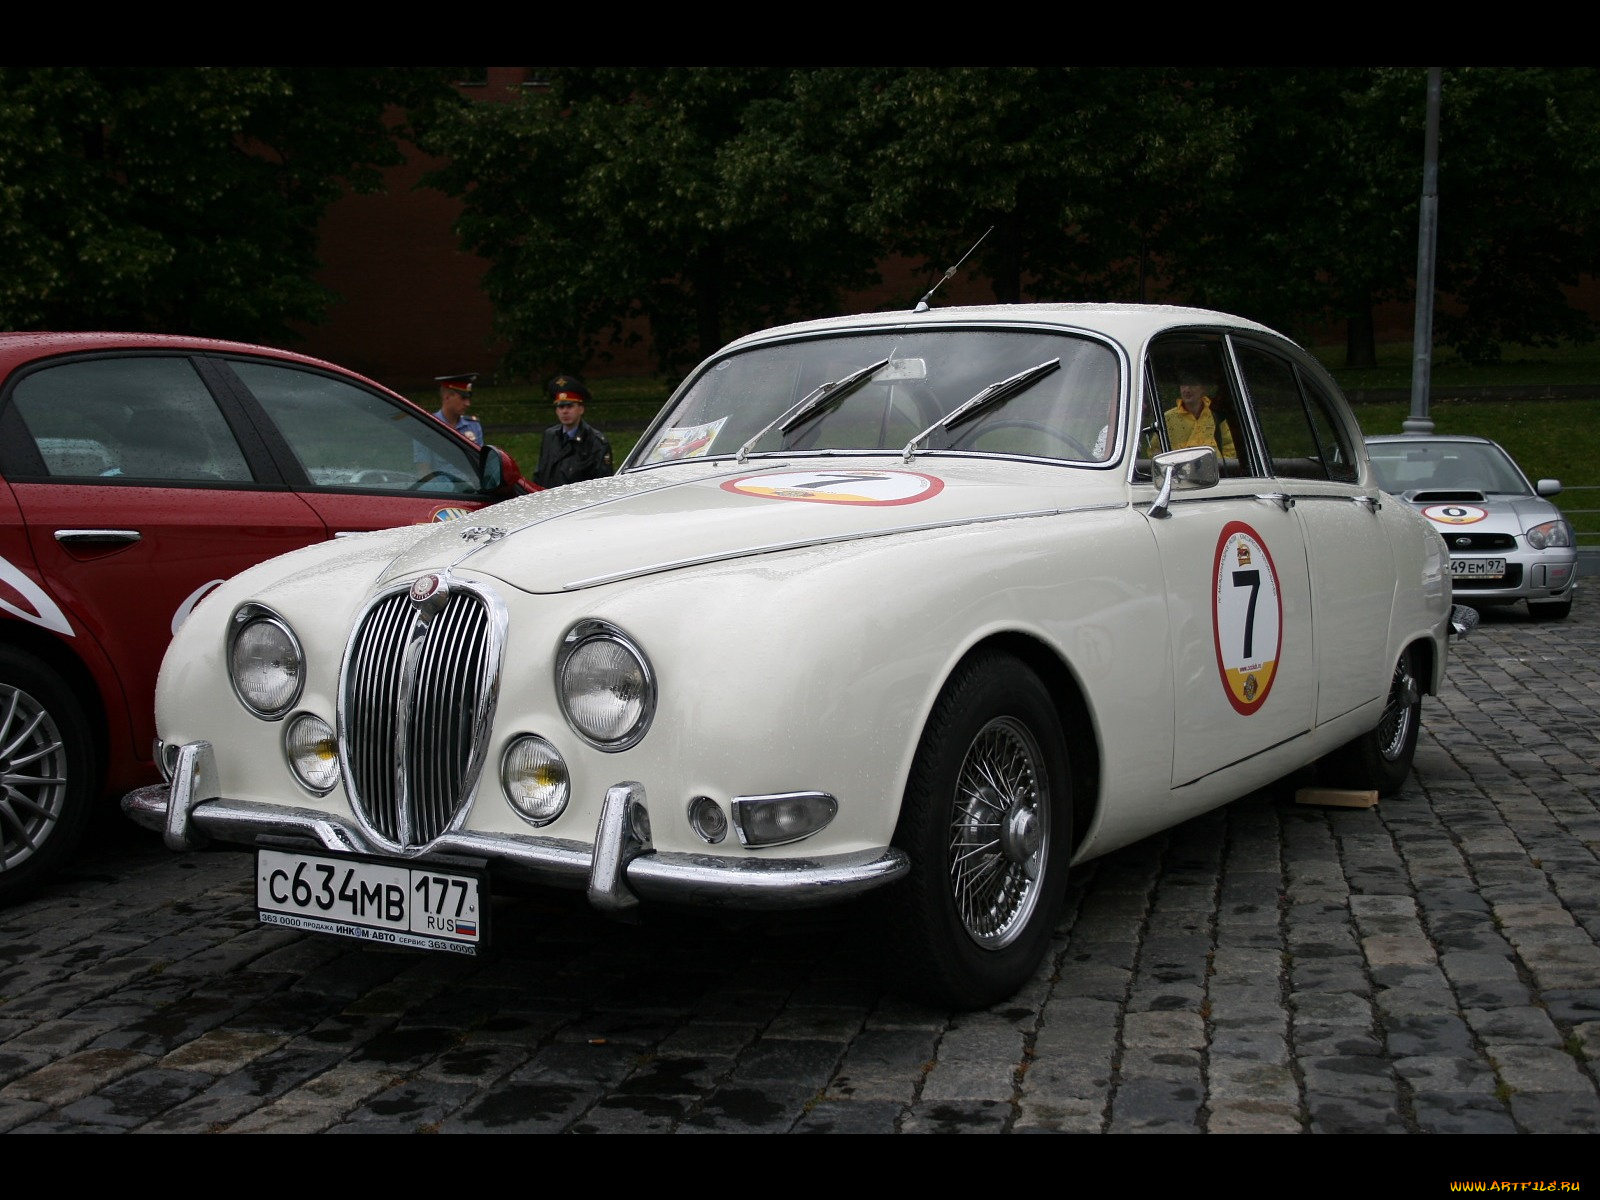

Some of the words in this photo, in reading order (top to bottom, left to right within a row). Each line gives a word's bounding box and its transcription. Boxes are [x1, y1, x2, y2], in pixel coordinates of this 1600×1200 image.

[790, 473, 892, 489] 7
[1488, 560, 1501, 570] 97
[1231, 569, 1261, 659] 7
[269, 861, 405, 922] С634МВ
[414, 875, 469, 918] 177
[261, 913, 278, 923] 363
[279, 917, 301, 927] 0000
[303, 921, 334, 931] ПРОДАЖА
[398, 937, 426, 947] СЕРВИС
[428, 940, 447, 949] 363
[426, 915, 455, 933] RUS
